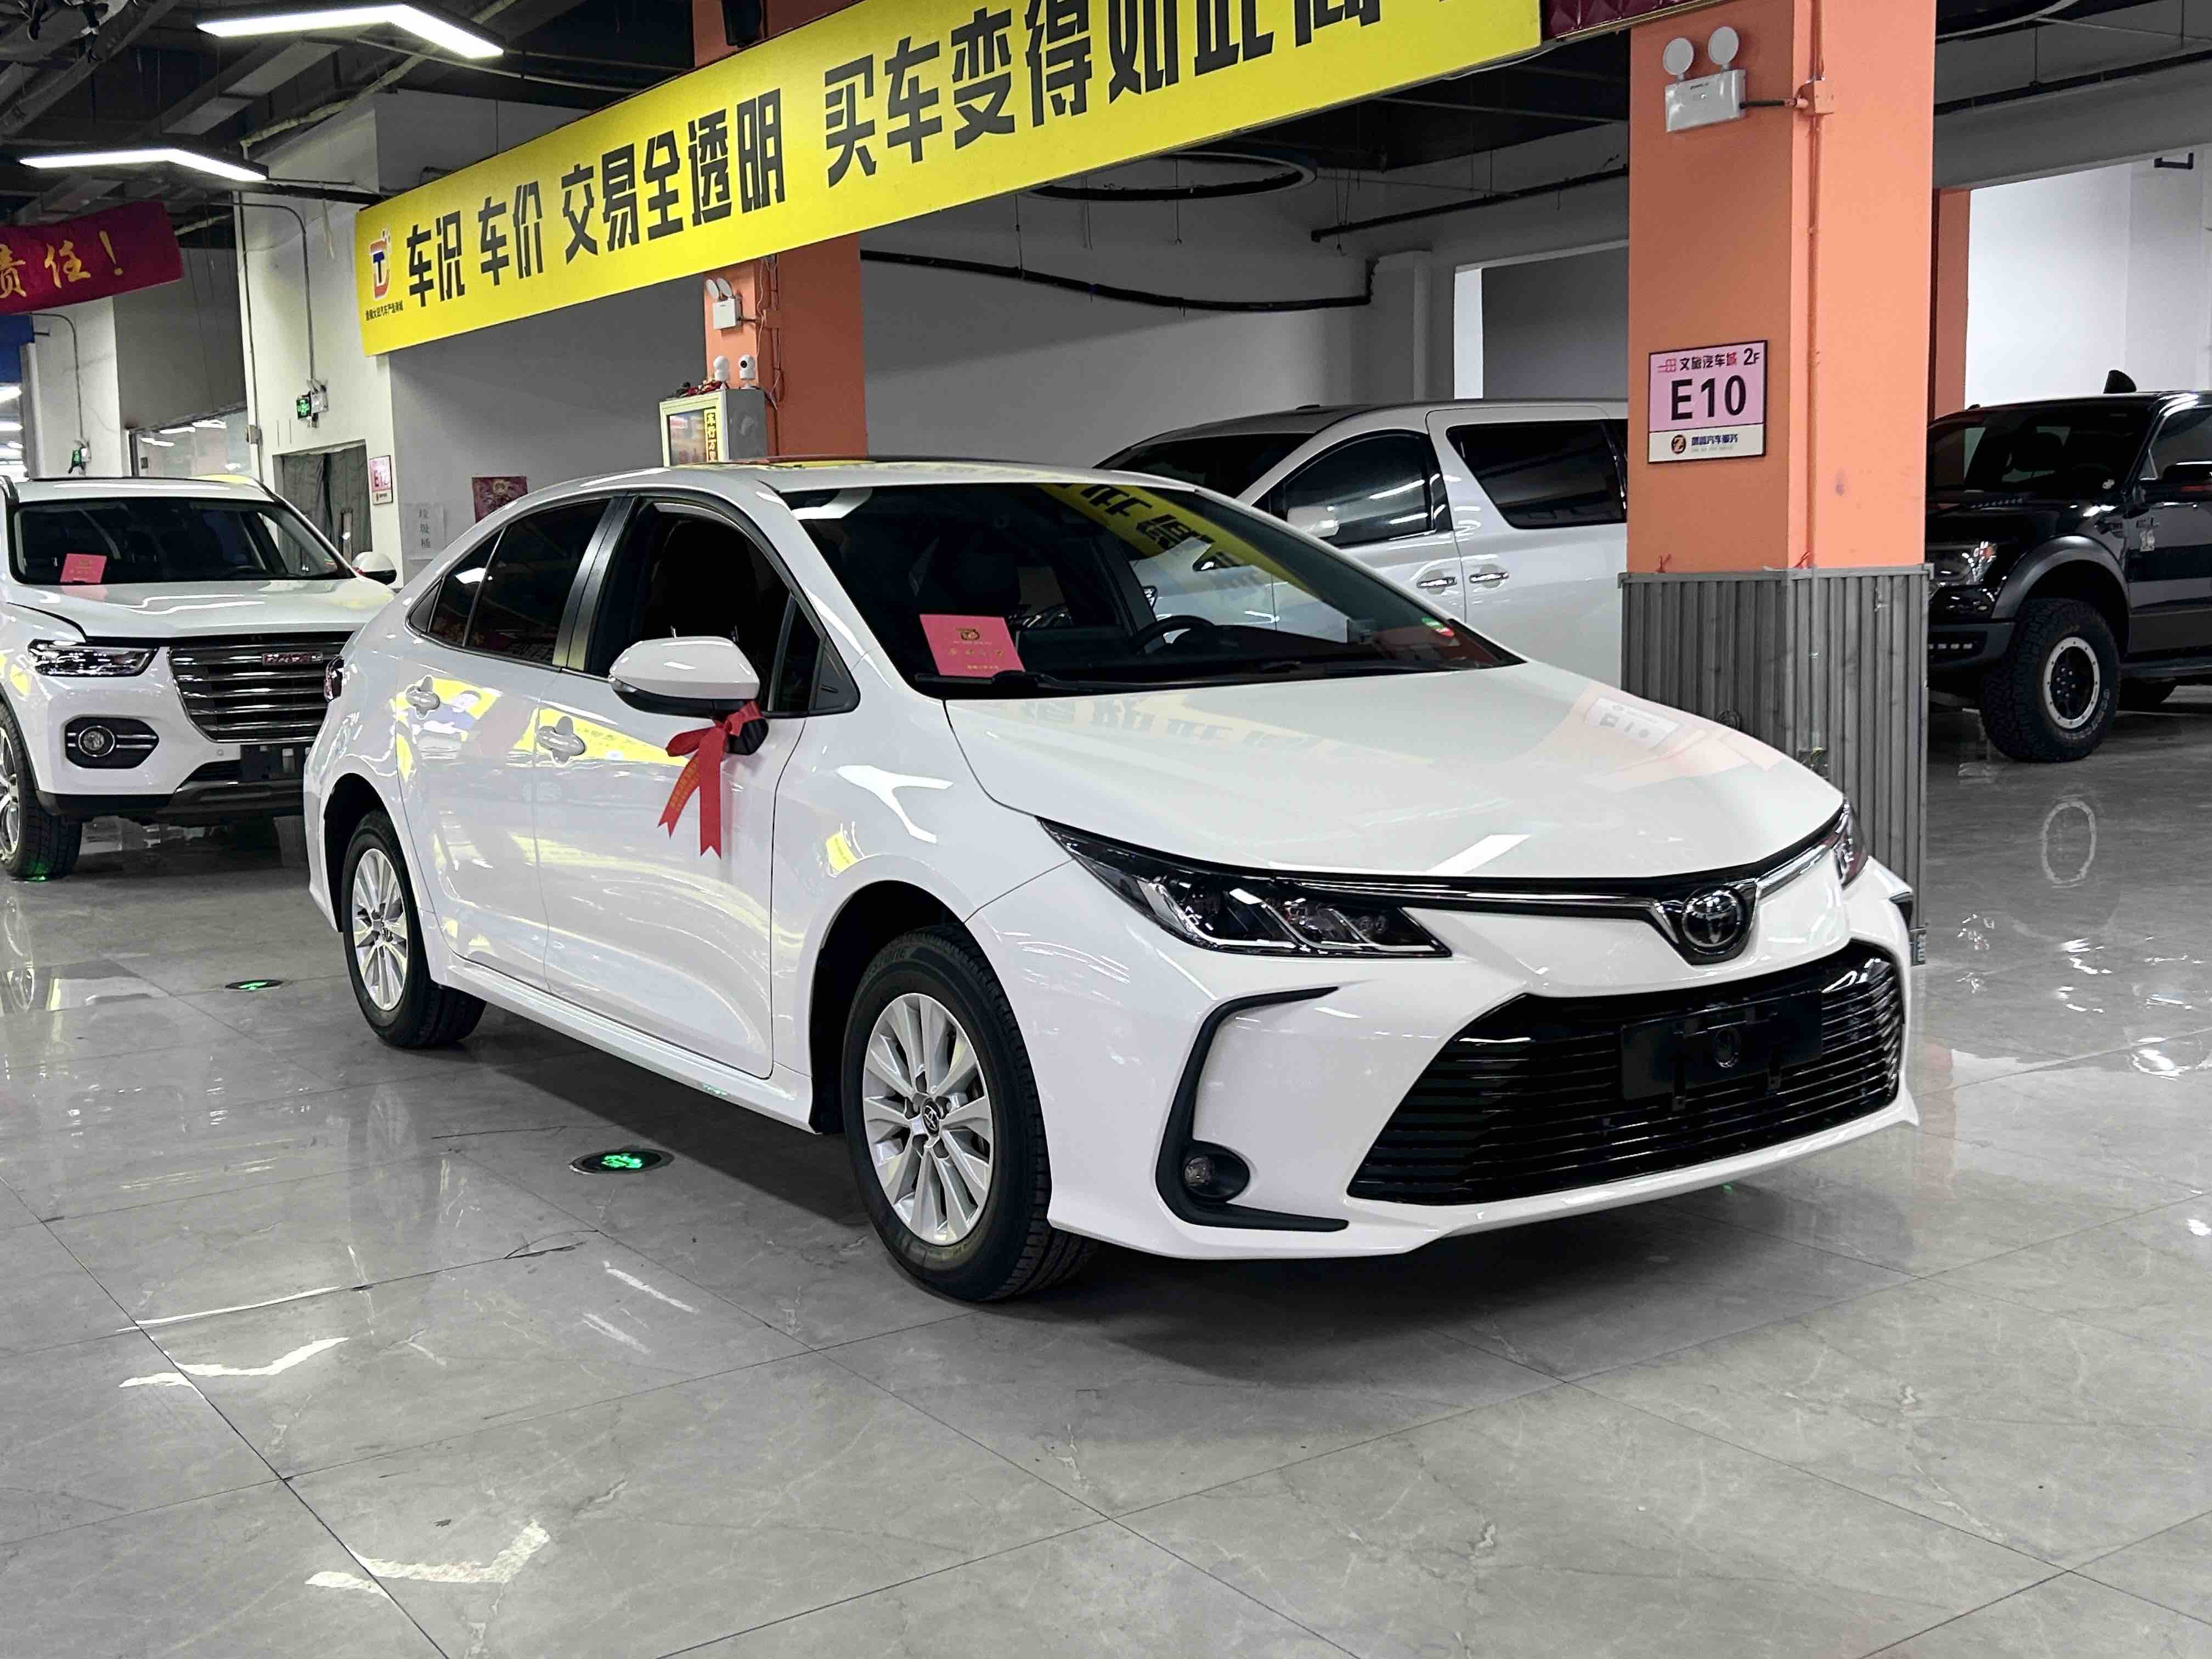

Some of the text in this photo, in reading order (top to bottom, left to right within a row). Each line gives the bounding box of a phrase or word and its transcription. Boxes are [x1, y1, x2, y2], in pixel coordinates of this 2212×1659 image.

[406, 210, 465, 307] 车况
[478, 180, 544, 286] 车价
[561, 88, 786, 263] 交易全透明
[1743, 347, 1760, 366] 2F
[1671, 375, 1746, 421] E10
